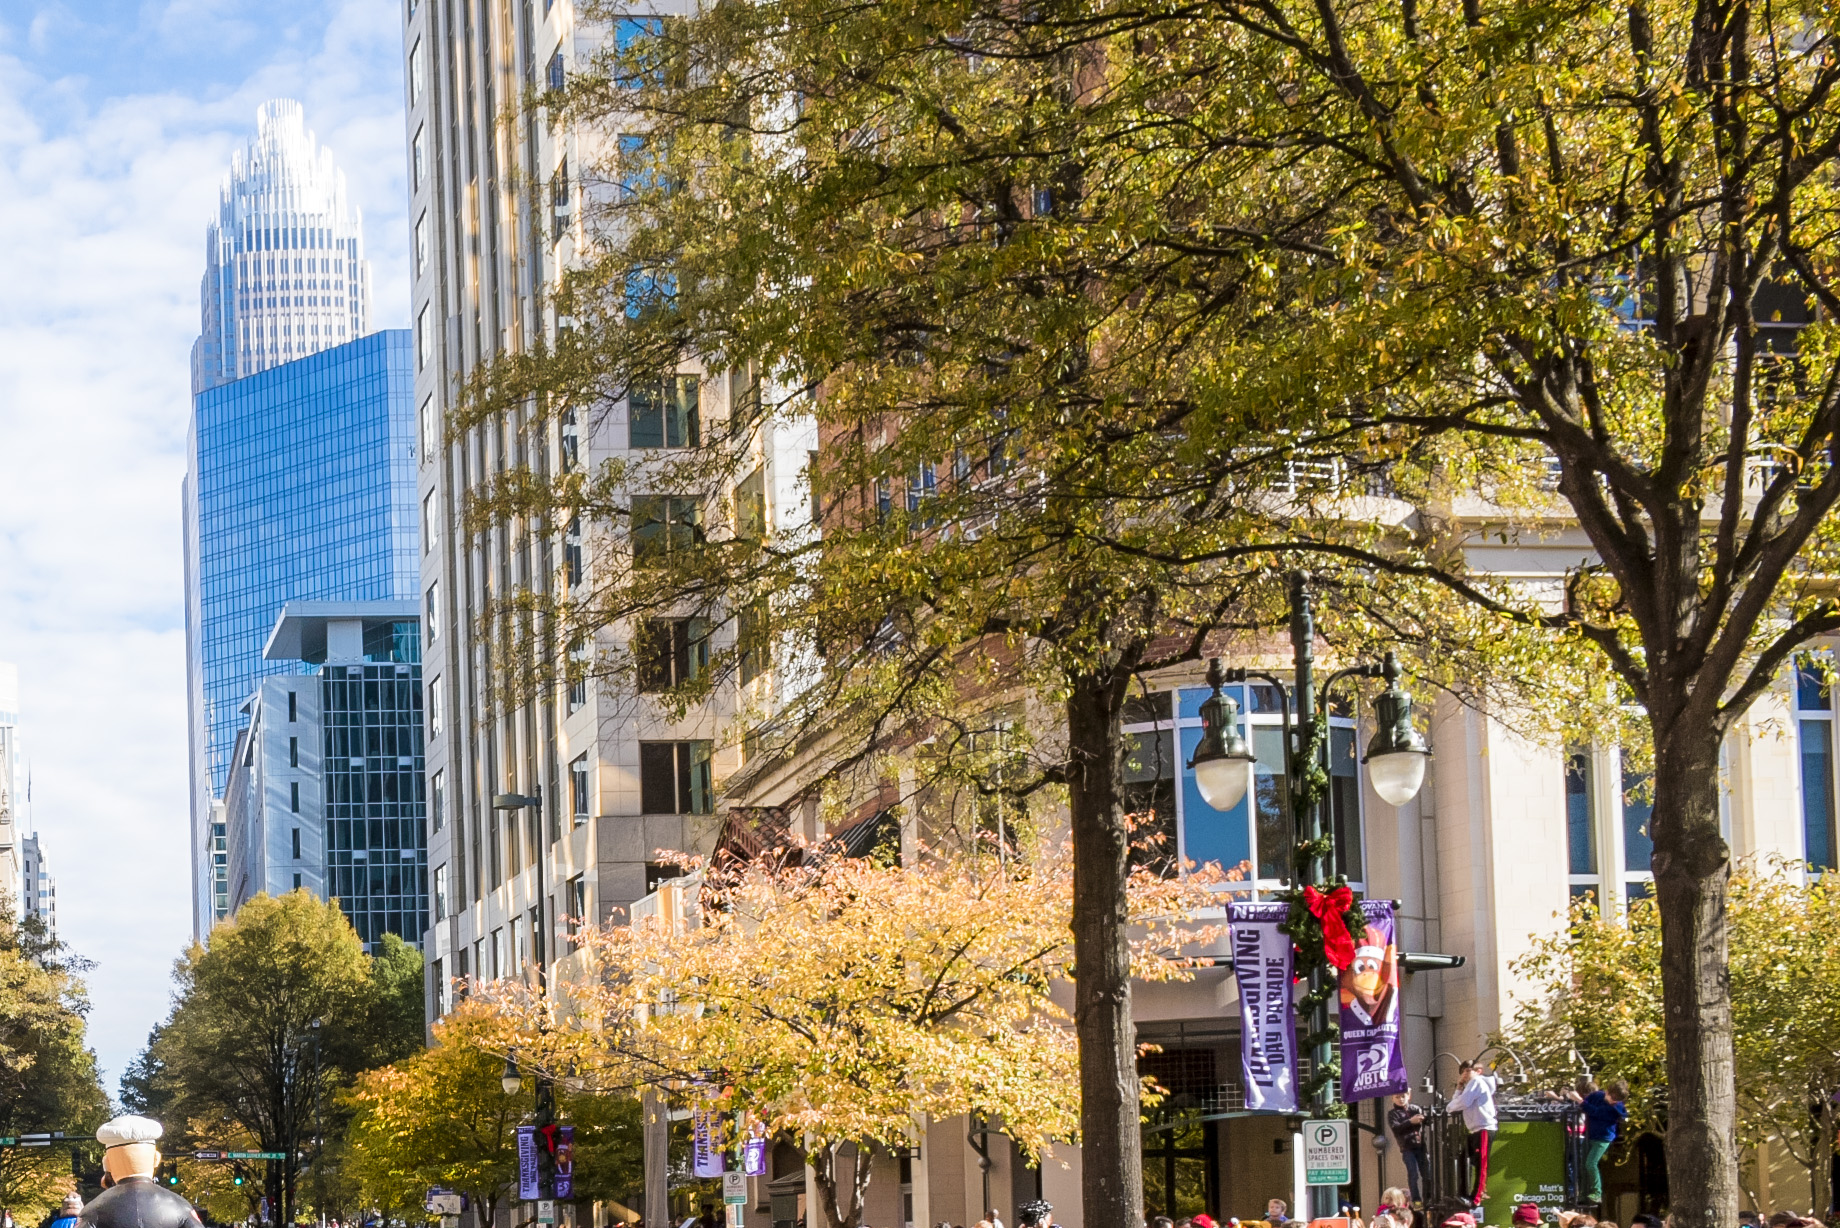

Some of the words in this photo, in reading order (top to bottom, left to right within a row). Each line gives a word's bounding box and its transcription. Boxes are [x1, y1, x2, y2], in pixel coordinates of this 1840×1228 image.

[1361, 903, 1388, 911] OVANT
[1266, 957, 1285, 1024] PARADE
[1265, 1030, 1285, 1065] DAY
[520, 1136, 530, 1193] THANKSGIVING
[1513, 1193, 1546, 1203] Chicago
[1547, 1193, 1564, 1203] Dog
[1539, 1184, 1564, 1192] Matt's
